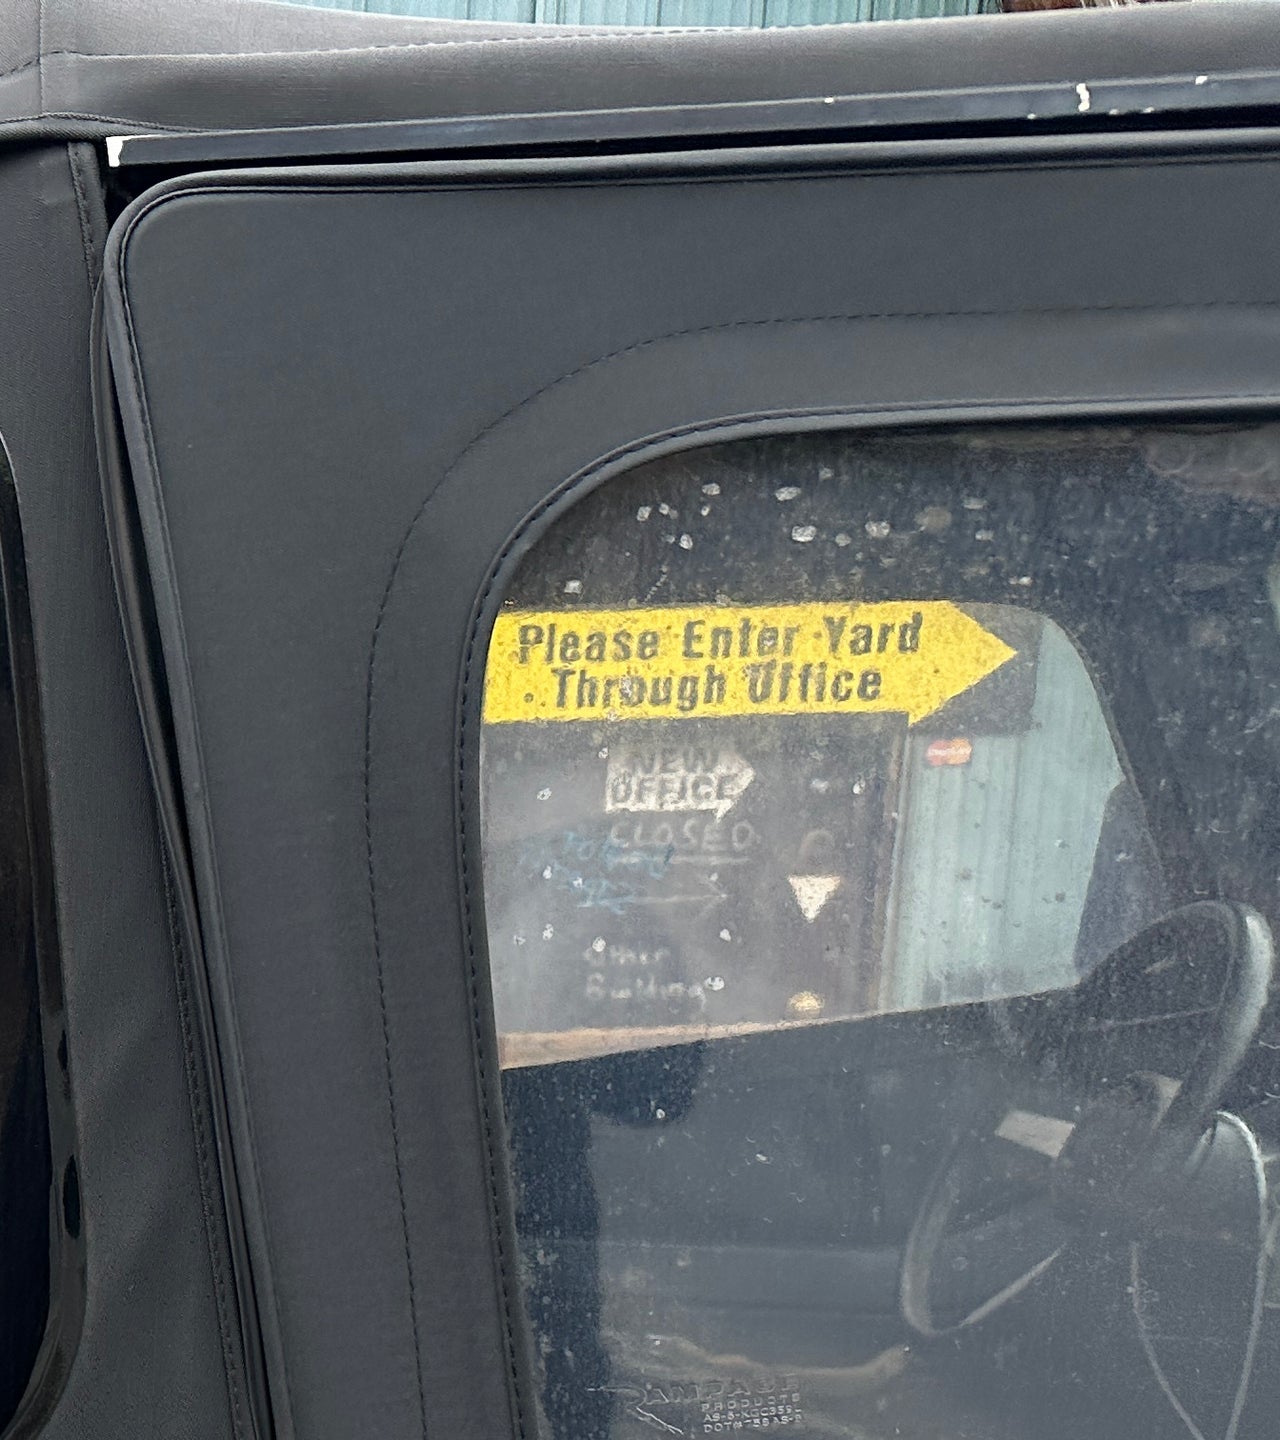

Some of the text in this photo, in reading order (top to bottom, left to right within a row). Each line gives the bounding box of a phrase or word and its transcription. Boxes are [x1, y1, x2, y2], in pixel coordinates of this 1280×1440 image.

[518, 611, 923, 664] Please Enter Yard
[551, 659, 882, 711] Through Office
[613, 769, 742, 804] OFFICE
[611, 819, 758, 851] CLOSED
[701, 1393, 800, 1412] PRODUCTS
